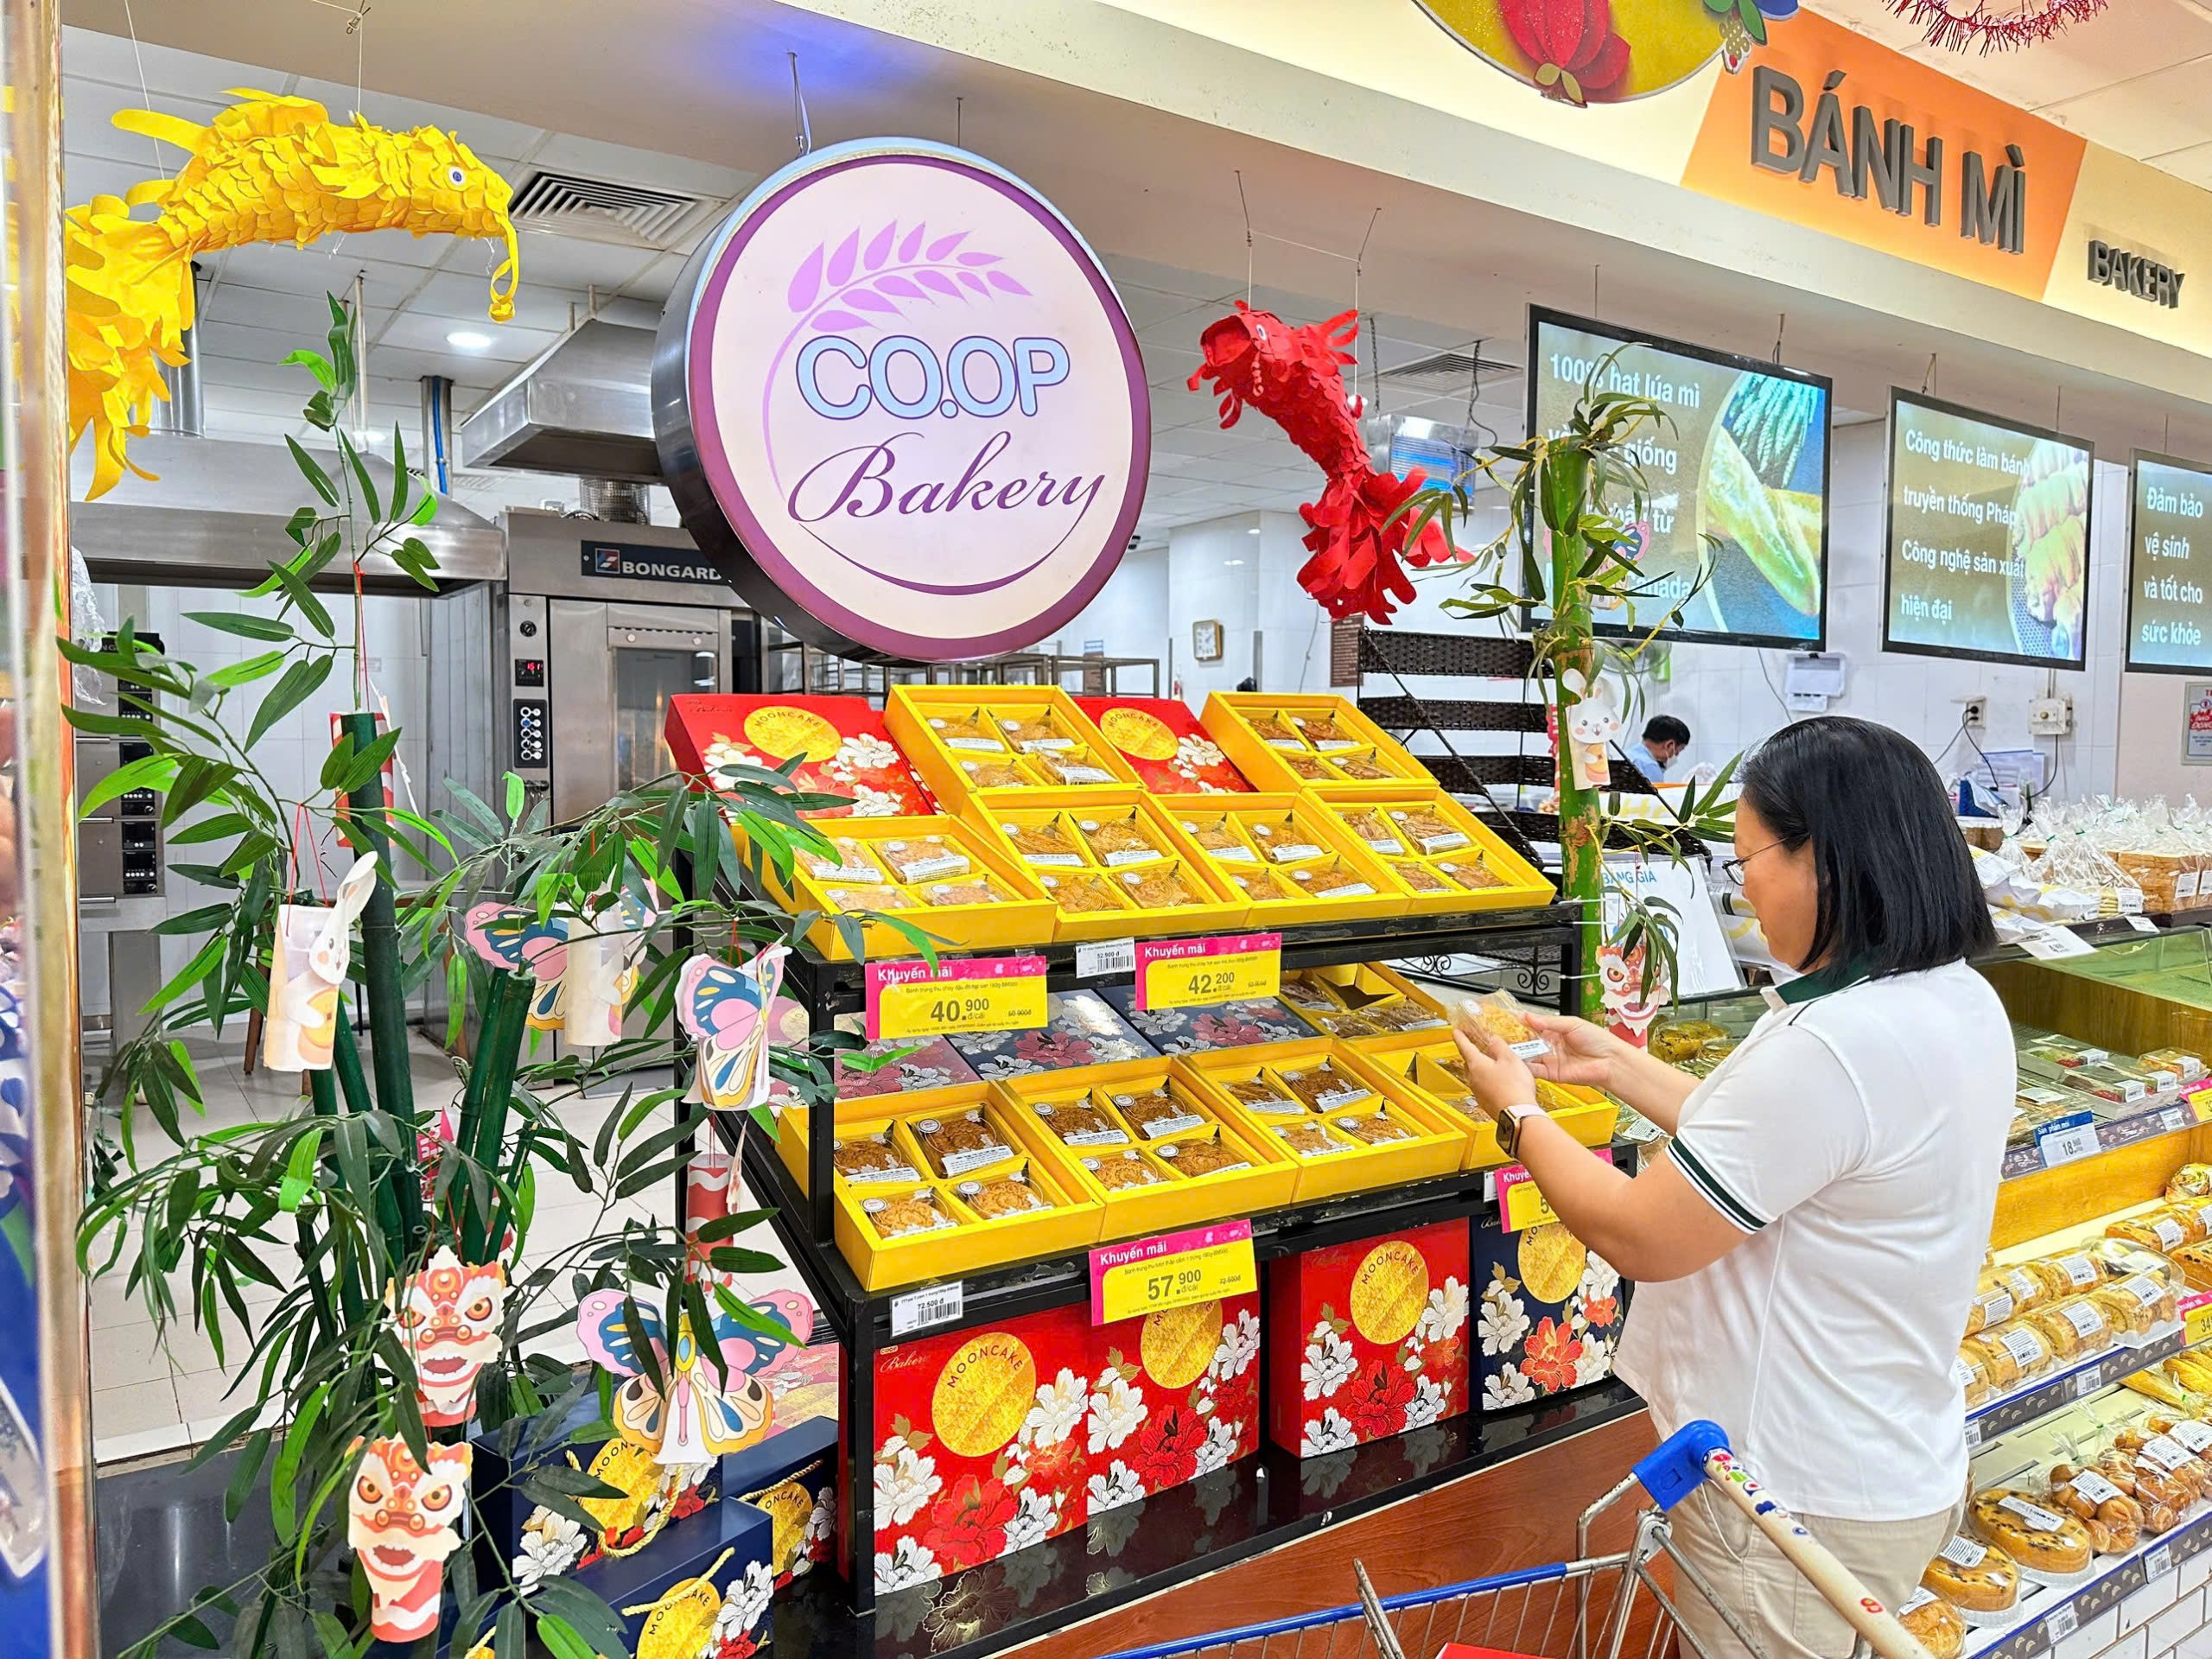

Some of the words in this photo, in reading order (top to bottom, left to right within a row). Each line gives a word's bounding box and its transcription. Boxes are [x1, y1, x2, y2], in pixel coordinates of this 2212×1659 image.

[1751, 65, 1942, 227] BÁNH
[1960, 143, 2026, 255] MÌ
[2088, 239, 2185, 308] BAKERY
[795, 334, 1071, 420] CO.OP
[1550, 353, 1604, 388] 100%
[1645, 373, 1673, 403] lúa
[1678, 383, 1700, 408] mì
[1905, 429, 1940, 461] Công
[1943, 439, 1974, 464] thức
[1976, 446, 1999, 469] làm
[2001, 452, 2031, 475] bánh
[787, 430, 1105, 536] Bakery
[1904, 486, 1944, 513] truyền
[1948, 493, 1983, 524] thống
[1986, 502, 2018, 531] Pháp
[2146, 486, 2177, 513] Đảm
[2180, 493, 2203, 518] bảo
[1902, 539, 1936, 569] Công
[1940, 548, 1970, 575] nghệ
[1974, 551, 1996, 573] sản
[2145, 531, 2158, 561] vệ
[2162, 535, 2190, 559] sinh
[2144, 575, 2158, 599] và
[2160, 575, 2177, 601] tốt
[2180, 582, 2203, 604] cho
[1901, 594, 1929, 621] hiện
[1931, 598, 1952, 625] đại
[2142, 620, 2167, 643] sức
[2171, 620, 2202, 645] khỏe
[754, 711, 821, 728] MOONCAKE
[1145, 943, 1185, 959] Khuyến
[1100, 1244, 1143, 1266] Khuyến
[1147, 1240, 1167, 1257] mãi
[1361, 1251, 1419, 1285] MOONCAKE
[947, 1344, 1023, 1388] MOONCAKE
